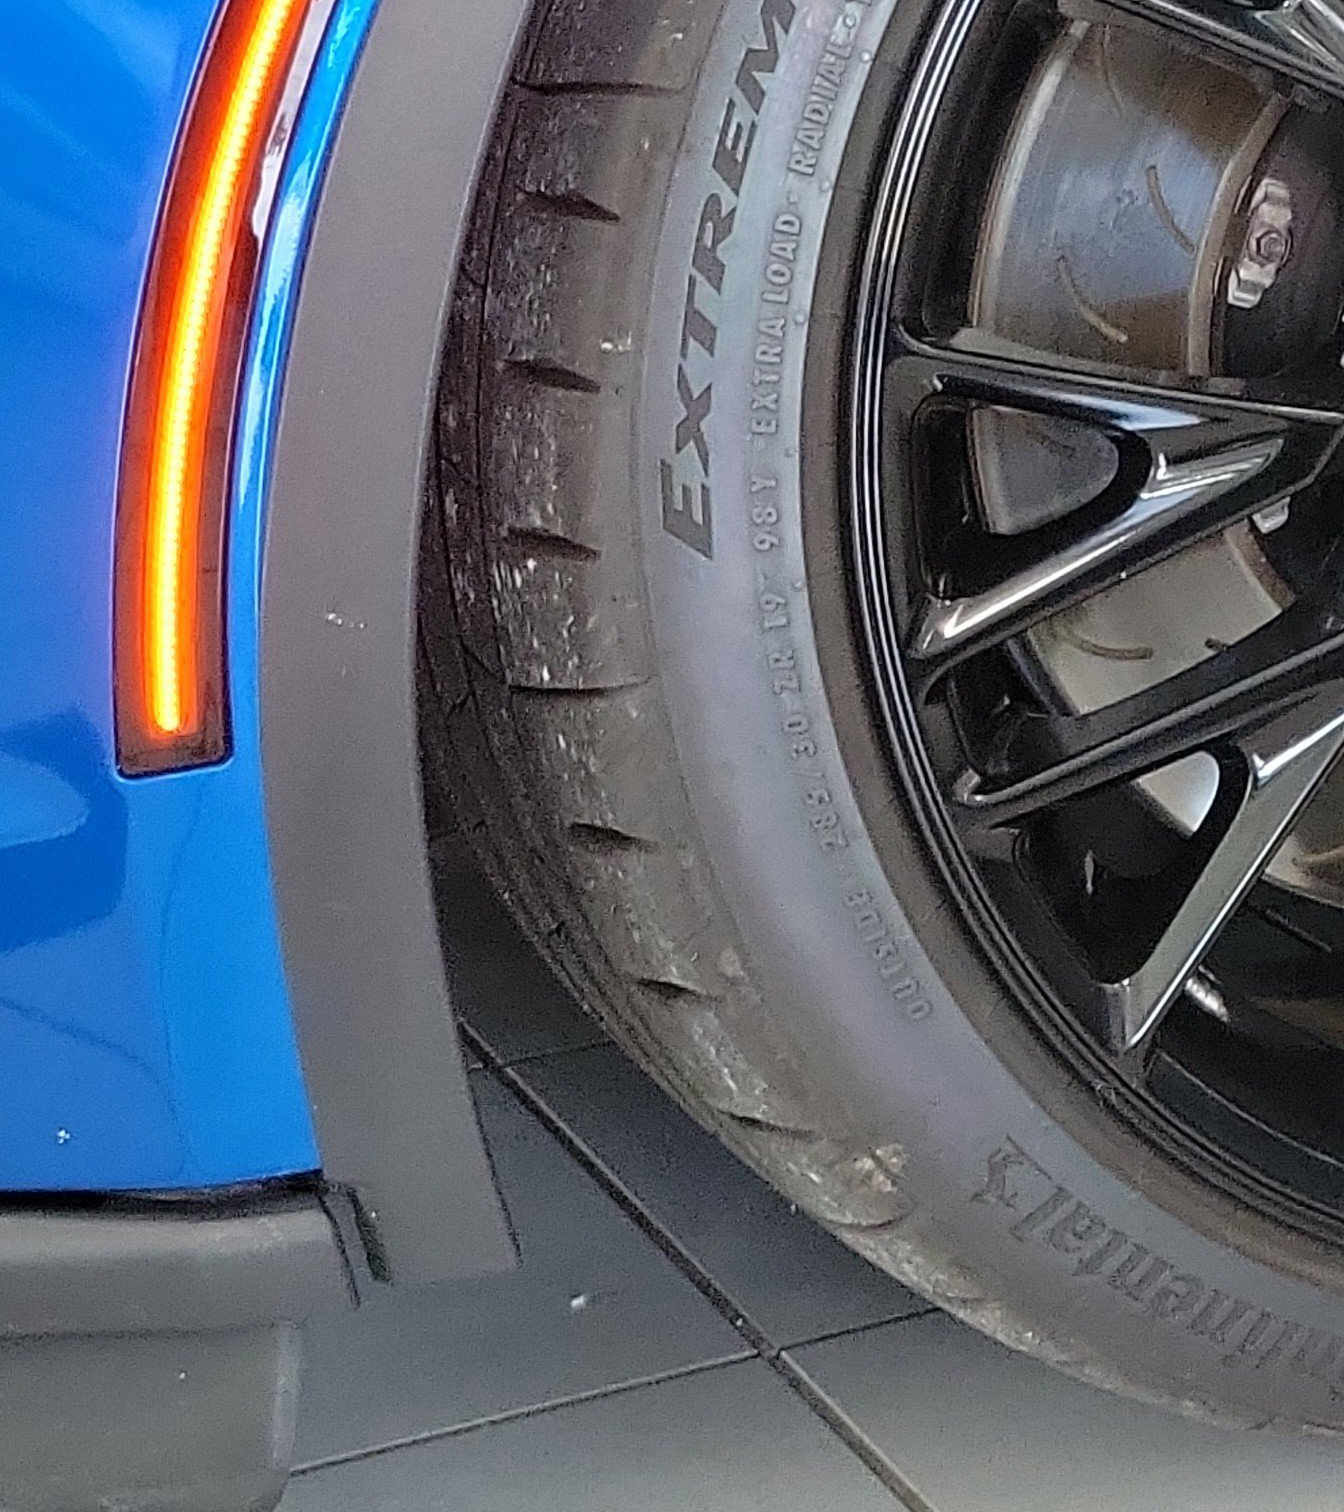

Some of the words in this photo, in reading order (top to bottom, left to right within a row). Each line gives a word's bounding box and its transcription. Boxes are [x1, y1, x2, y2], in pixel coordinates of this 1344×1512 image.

[788, 33, 856, 176] RADIAL
[761, 211, 802, 308] LOAD
[749, 311, 788, 435] EXTRA
